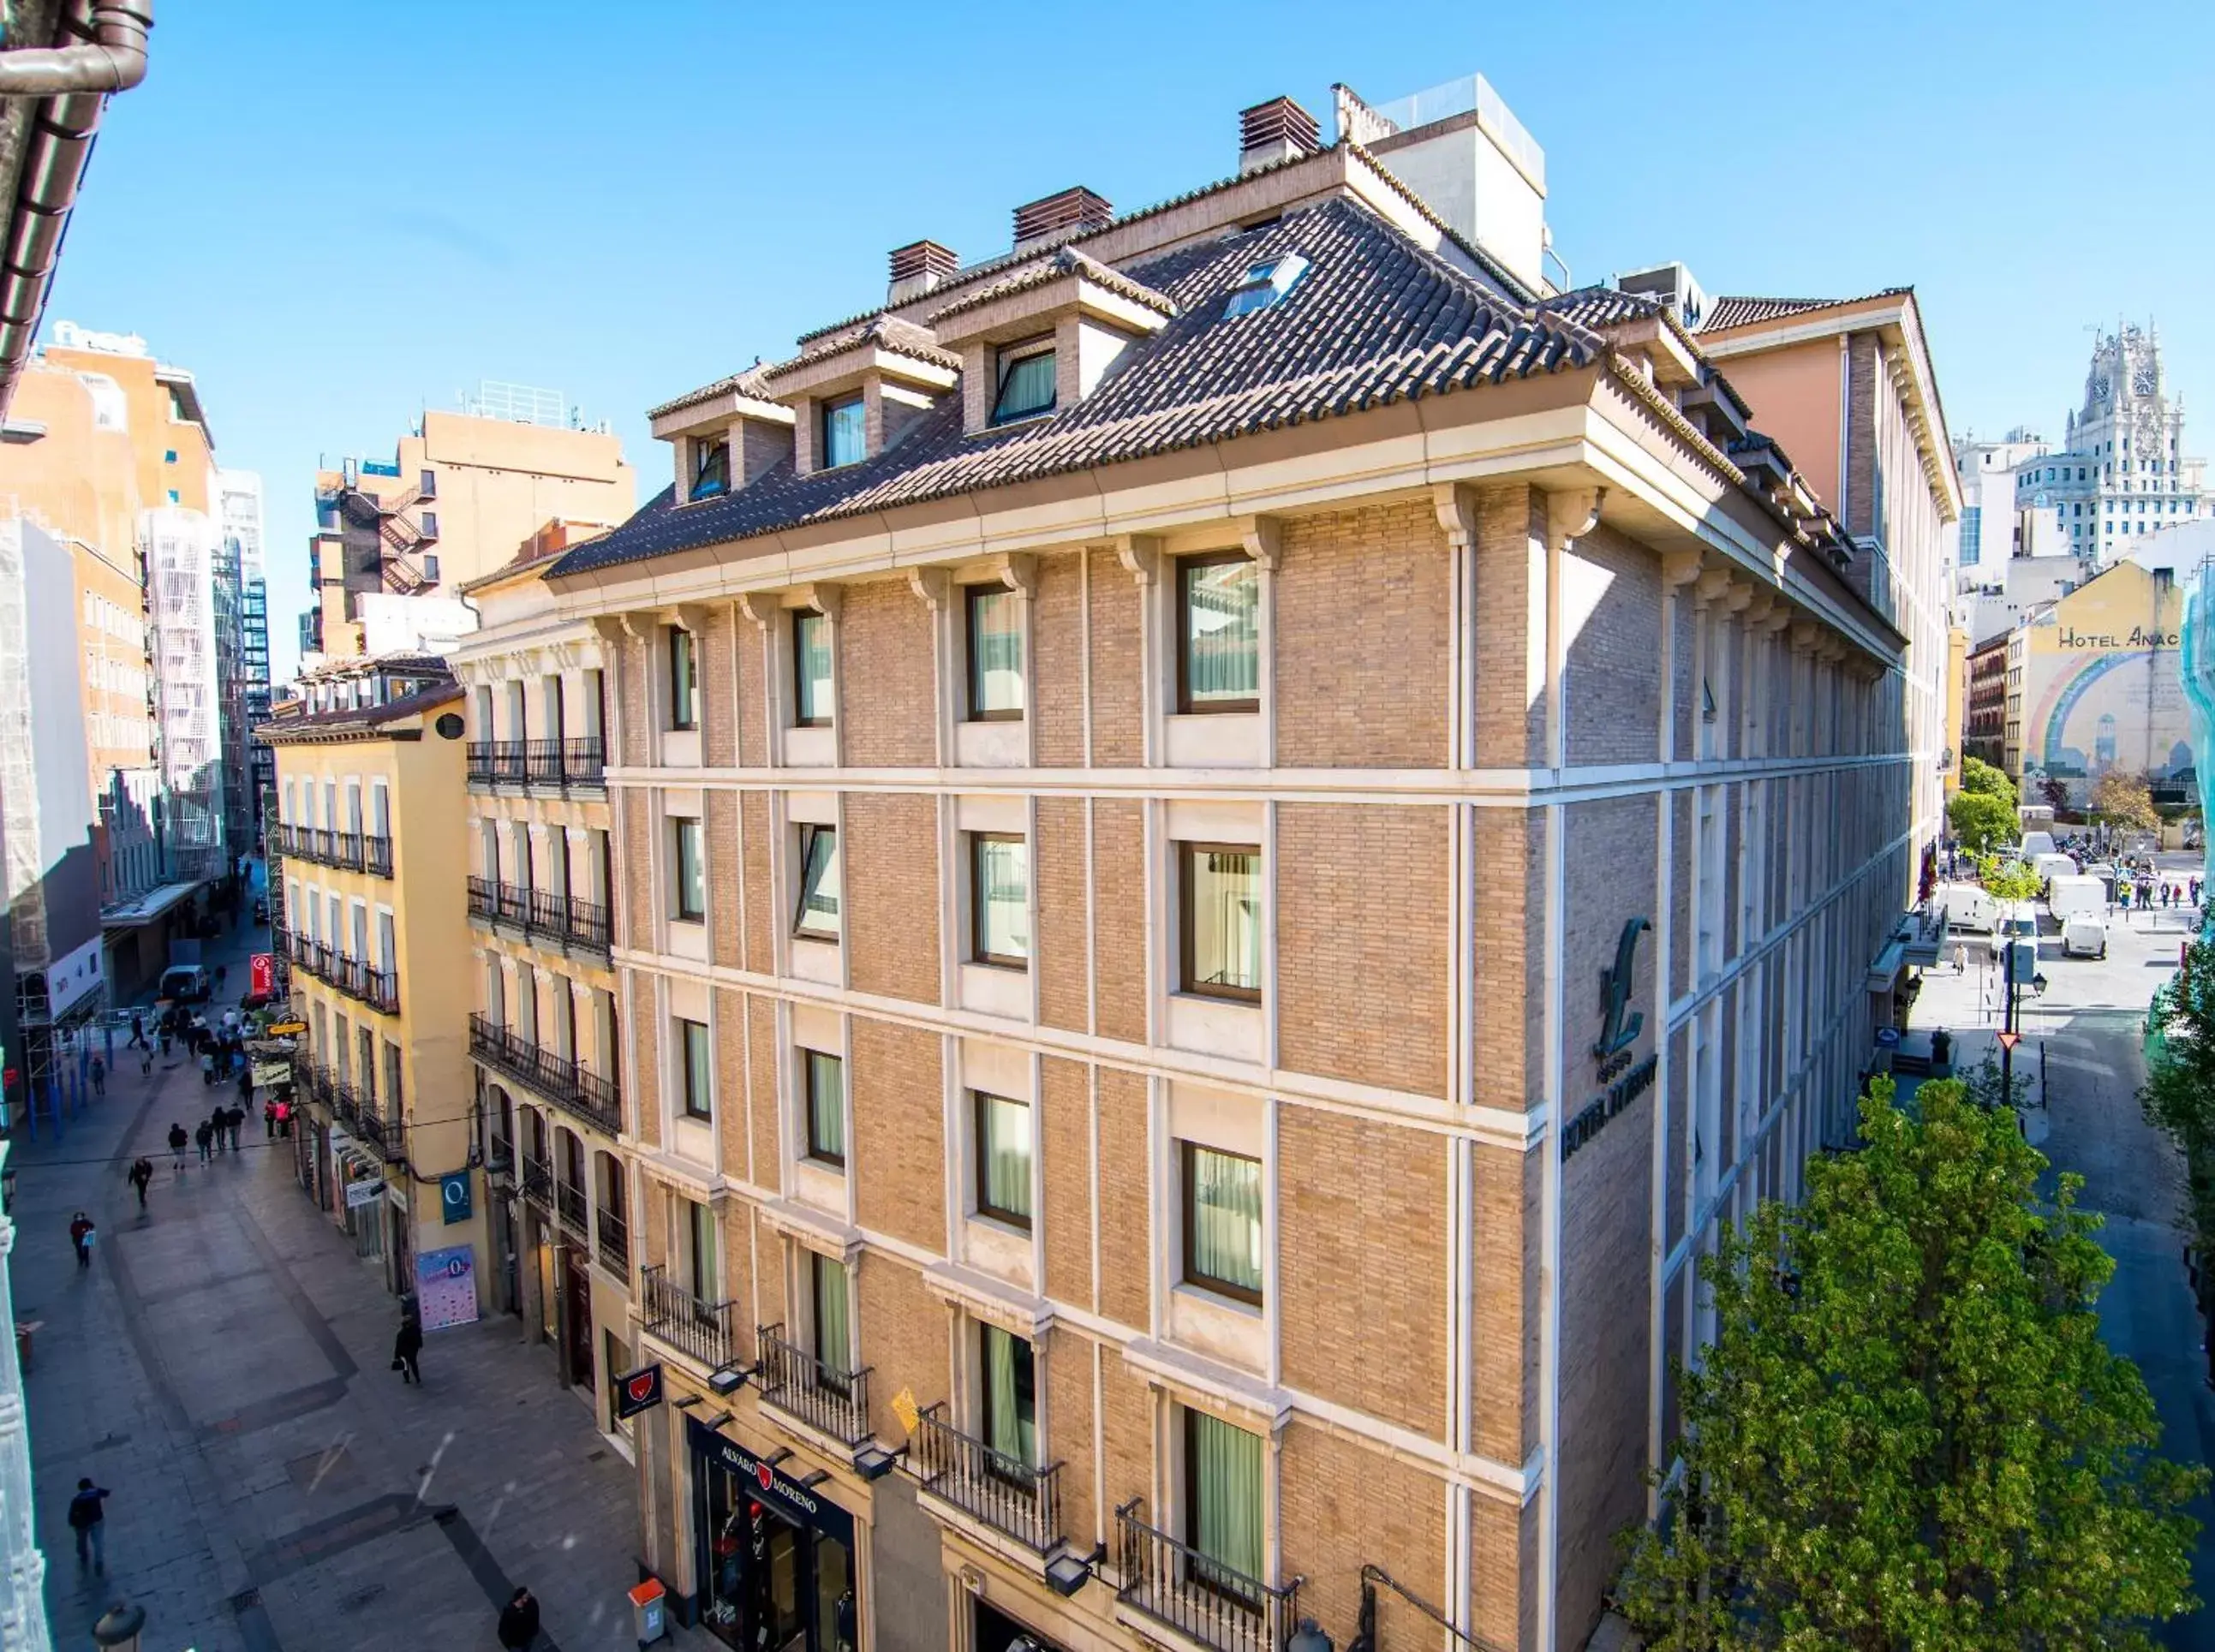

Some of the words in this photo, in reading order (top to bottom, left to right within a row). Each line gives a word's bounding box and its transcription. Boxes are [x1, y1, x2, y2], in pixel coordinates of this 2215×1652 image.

[2058, 626, 2119, 648] HOTEL
[721, 1446, 757, 1476] ALVARO
[773, 1476, 817, 1514] MORENO
